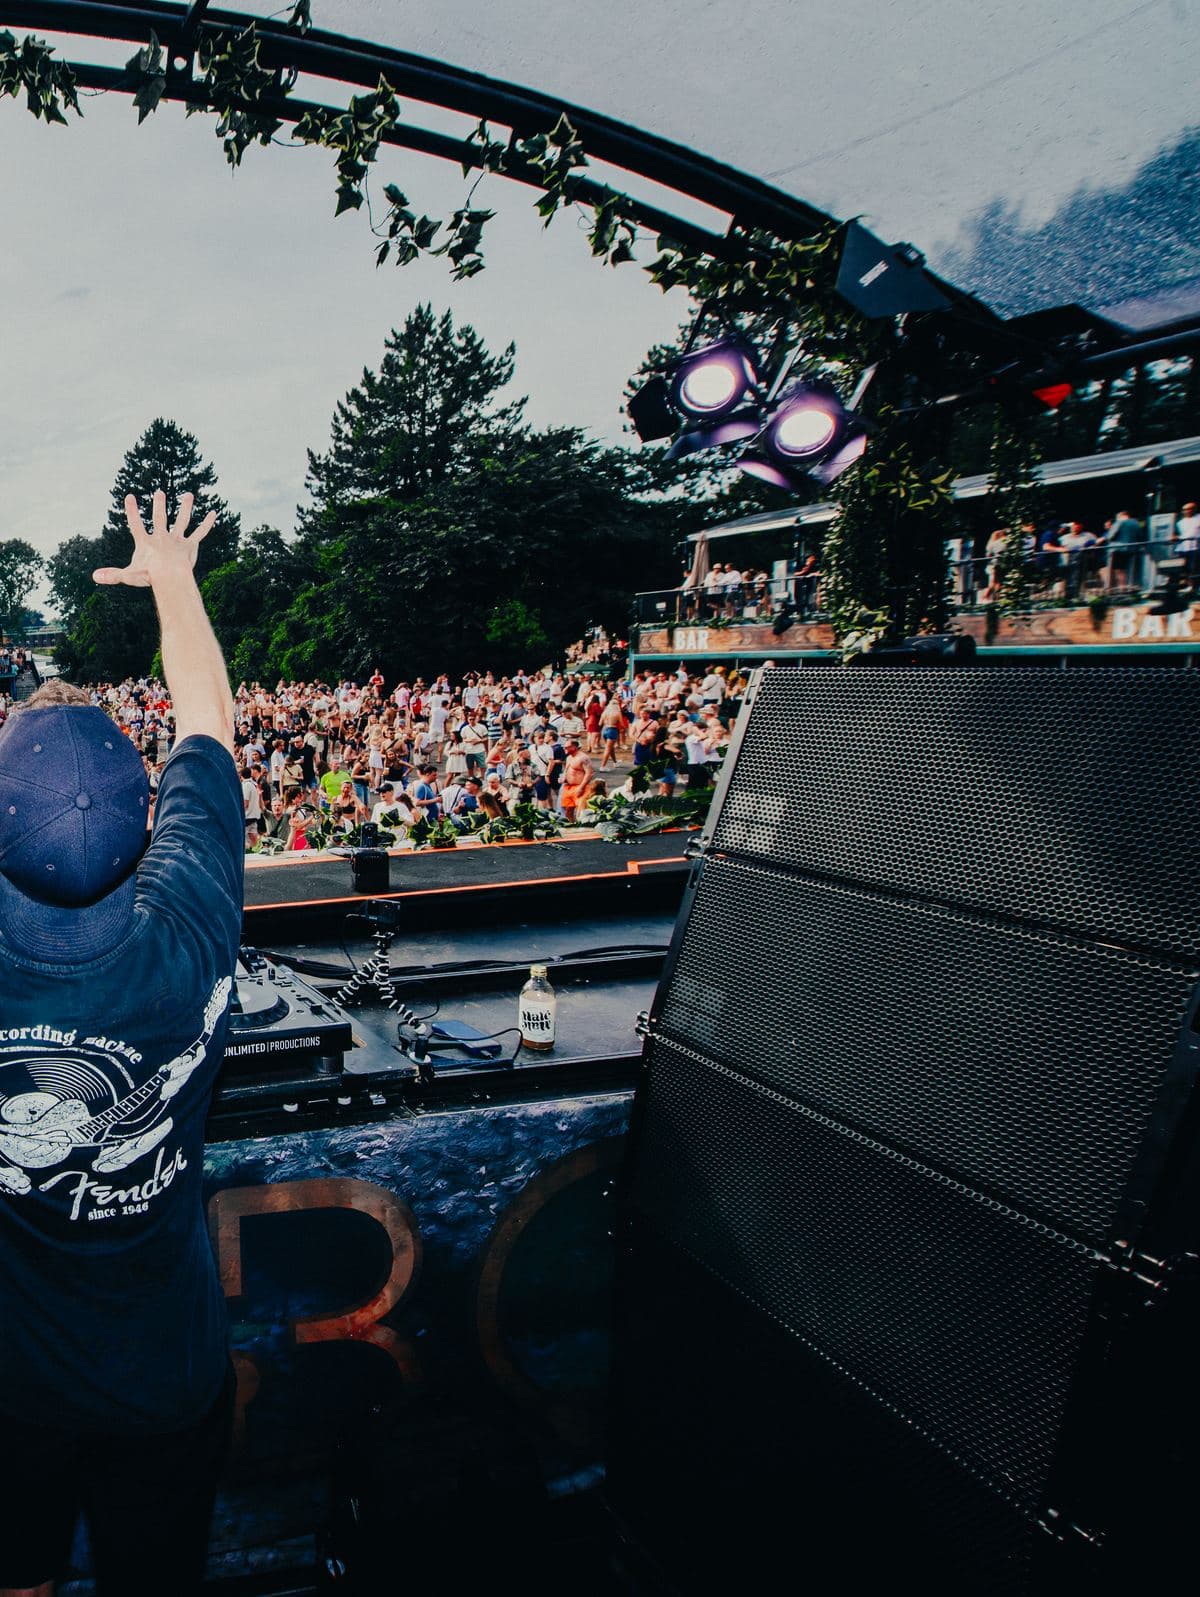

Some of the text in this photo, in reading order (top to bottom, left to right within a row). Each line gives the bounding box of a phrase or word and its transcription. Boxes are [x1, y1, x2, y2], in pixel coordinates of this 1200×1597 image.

[1112, 606, 1193, 640] BAR
[675, 629, 709, 650] BAR
[270, 1036, 321, 1052] PRODUCTIONS
[38, 1146, 188, 1221] Fender
[87, 1202, 149, 1221] since 1946
